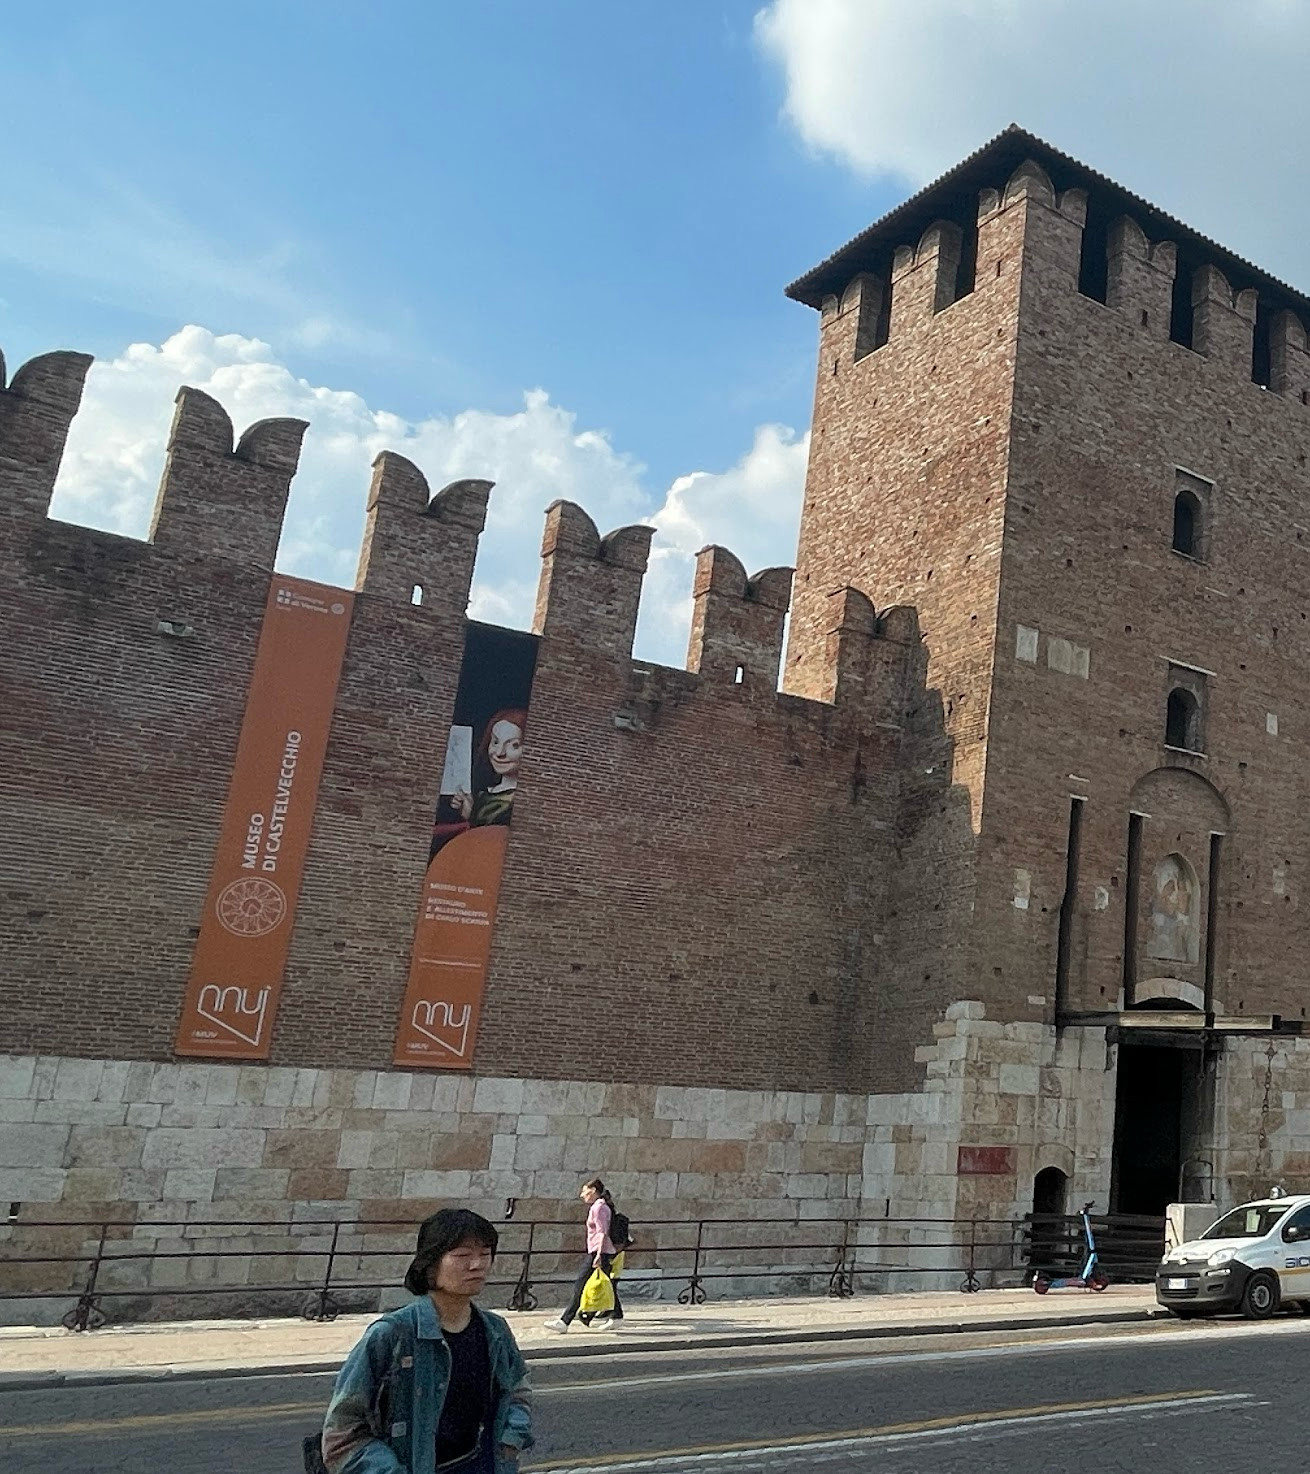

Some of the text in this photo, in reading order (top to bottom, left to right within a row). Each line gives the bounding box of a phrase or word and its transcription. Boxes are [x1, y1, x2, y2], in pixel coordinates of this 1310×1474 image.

[242, 813, 264, 869] MUSEO
[262, 730, 302, 872] DI CASTELVECCHIO
